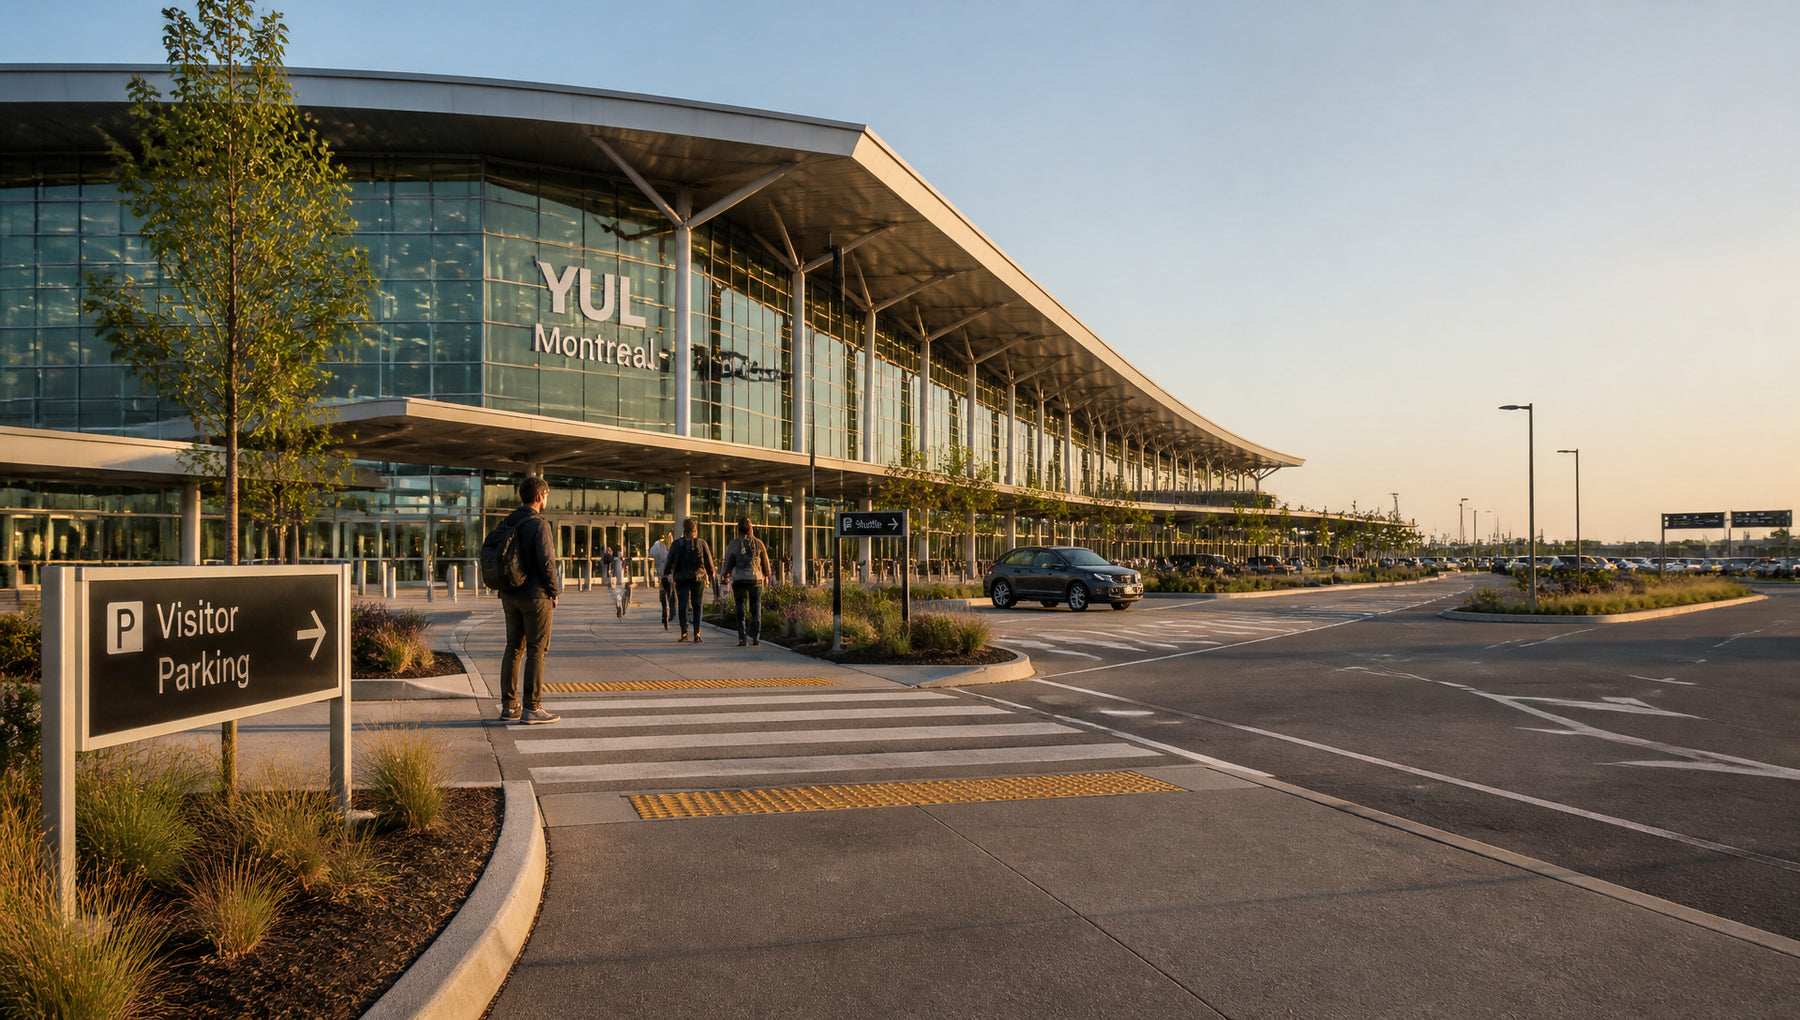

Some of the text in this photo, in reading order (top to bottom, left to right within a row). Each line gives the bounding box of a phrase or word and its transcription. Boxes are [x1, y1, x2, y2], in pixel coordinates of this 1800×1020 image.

[537, 261, 646, 328] YUL
[117, 608, 135, 649] P
[156, 600, 239, 639] Visitor
[158, 649, 250, 694] Parking
